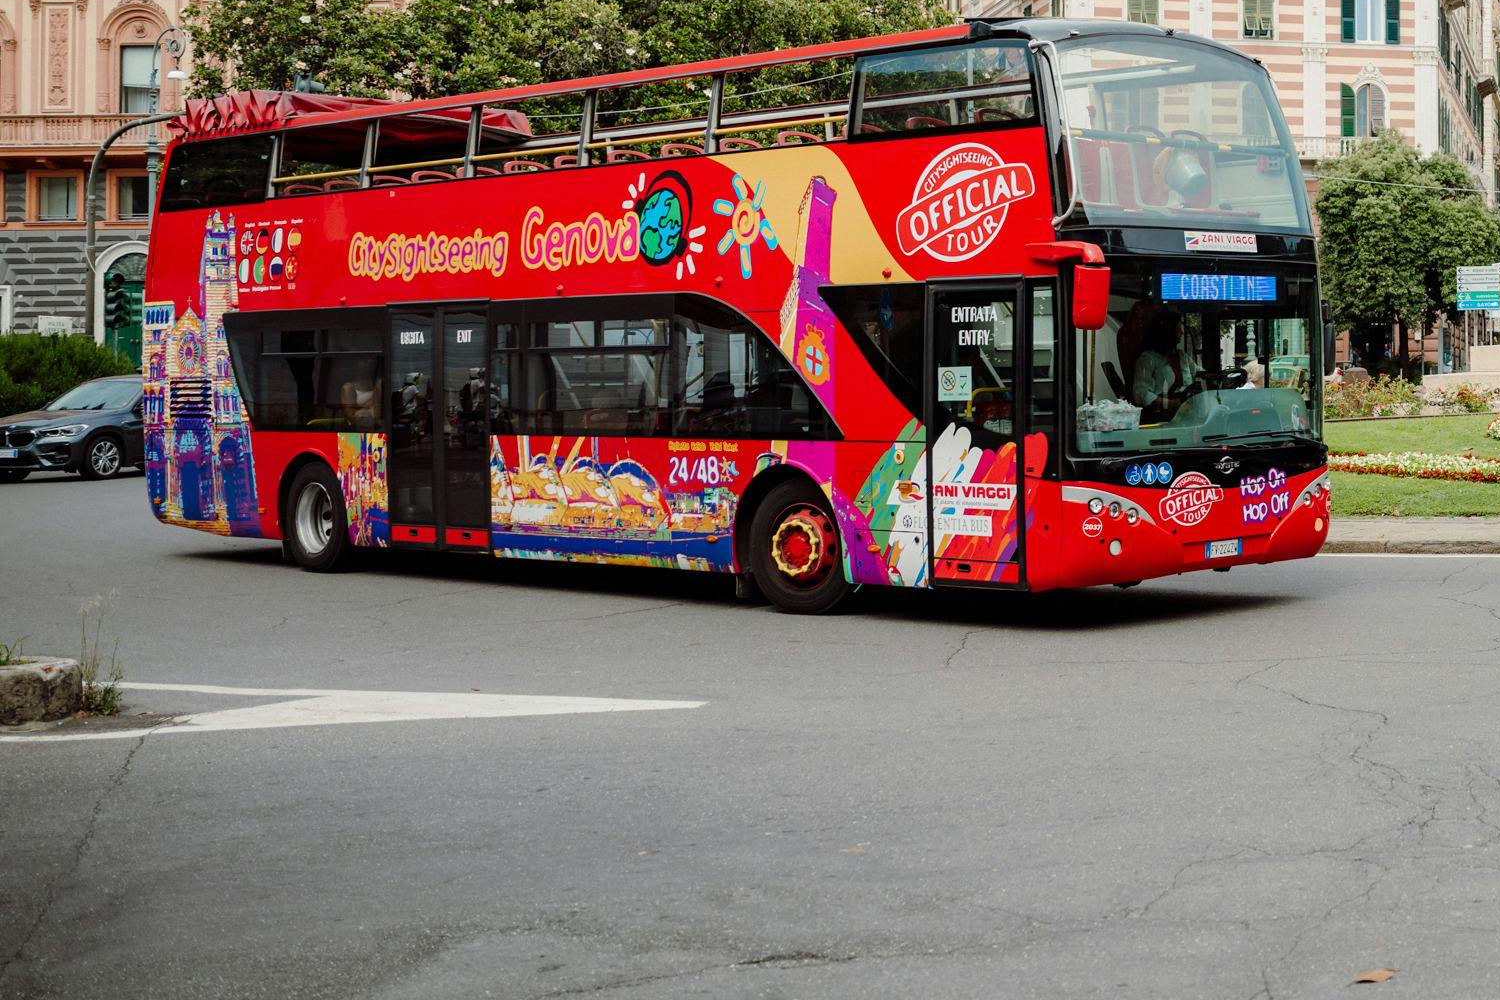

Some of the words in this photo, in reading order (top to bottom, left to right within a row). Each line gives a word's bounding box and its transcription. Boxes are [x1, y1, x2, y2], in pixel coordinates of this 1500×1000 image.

[924, 152, 994, 192] CITYSIGHTSEEING
[909, 169, 1025, 241] OFFICIAL
[946, 214, 999, 252] TOUR
[1201, 234, 1224, 243] ZANI
[1227, 235, 1257, 245] VIAGGI
[349, 229, 509, 282] CitySightseeing
[951, 306, 998, 323] ENTRATA
[400, 331, 425, 345] USCITA
[456, 329, 473, 343] EXIT
[958, 329, 990, 346] ENTRY
[668, 455, 720, 485] 24/48
[933, 485, 958, 497] ANI
[961, 485, 1011, 500] VIAGGI
[1240, 475, 1266, 497] Hop
[1268, 467, 1286, 489] On
[1165, 487, 1220, 515] OFFICIAL
[1242, 501, 1268, 522] Hop
[1270, 491, 1289, 514] Off
[913, 515, 968, 531] FLENTIA
[970, 519, 989, 533] BUS
[1183, 506, 1208, 522] TOUR
